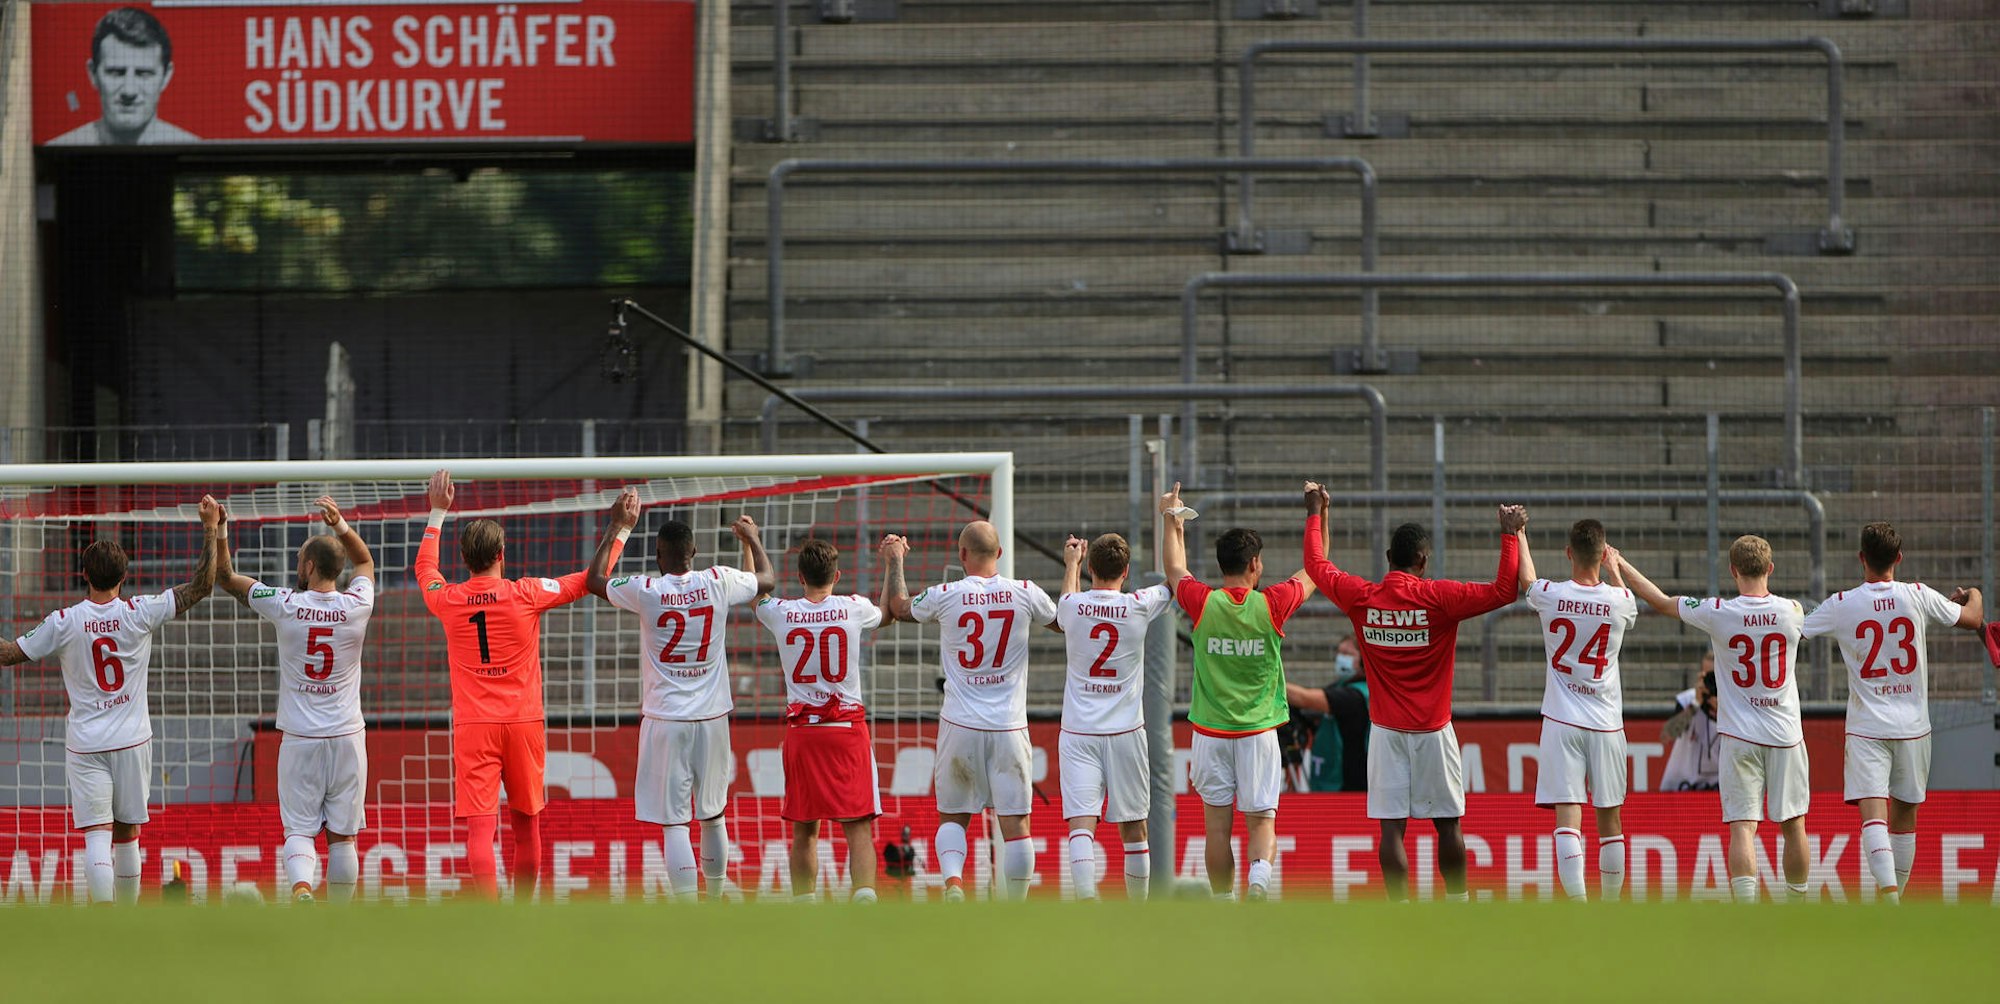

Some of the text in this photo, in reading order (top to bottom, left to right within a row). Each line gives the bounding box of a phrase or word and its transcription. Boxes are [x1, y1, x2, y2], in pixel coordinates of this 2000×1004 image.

[245, 6, 616, 69] HANS SCHÄFER
[245, 70, 506, 133] SÜDKURVE
[467, 593, 497, 605] HORN
[661, 588, 708, 606] MODESTE
[962, 591, 1013, 606] LEISTNER
[1873, 599, 1895, 612] UTH
[297, 607, 347, 622] CZICHOS
[786, 609, 848, 623] REXHBECAJ
[1077, 604, 1128, 618] SCHMITZ
[1366, 608, 1429, 627] REWE
[1557, 600, 1610, 617] DREXLER
[84, 619, 120, 633] HÖGER
[1743, 614, 1777, 627] KAINZ
[469, 611, 490, 664] 1
[657, 605, 714, 663] 27
[958, 609, 1015, 669] 37
[1366, 630, 1427, 645] uhlsport
[304, 627, 334, 681] 5
[786, 626, 848, 683] 20
[1089, 623, 1119, 677] 2
[1207, 637, 1265, 656] REWE
[1549, 618, 1611, 679] 24
[1856, 617, 1917, 679] 23
[92, 637, 124, 692] 6
[1729, 633, 1787, 688] 30
[974, 676, 984, 685] FC
[986, 675, 1005, 684] KÖLN
[1092, 684, 1102, 693] FC
[1103, 682, 1121, 693] KÖLN
[1882, 685, 1892, 695] FC
[1893, 683, 1912, 694] KÖLN
[1750, 696, 1779, 707] FC KÖLN
[0, 845, 323, 906] WIDER
